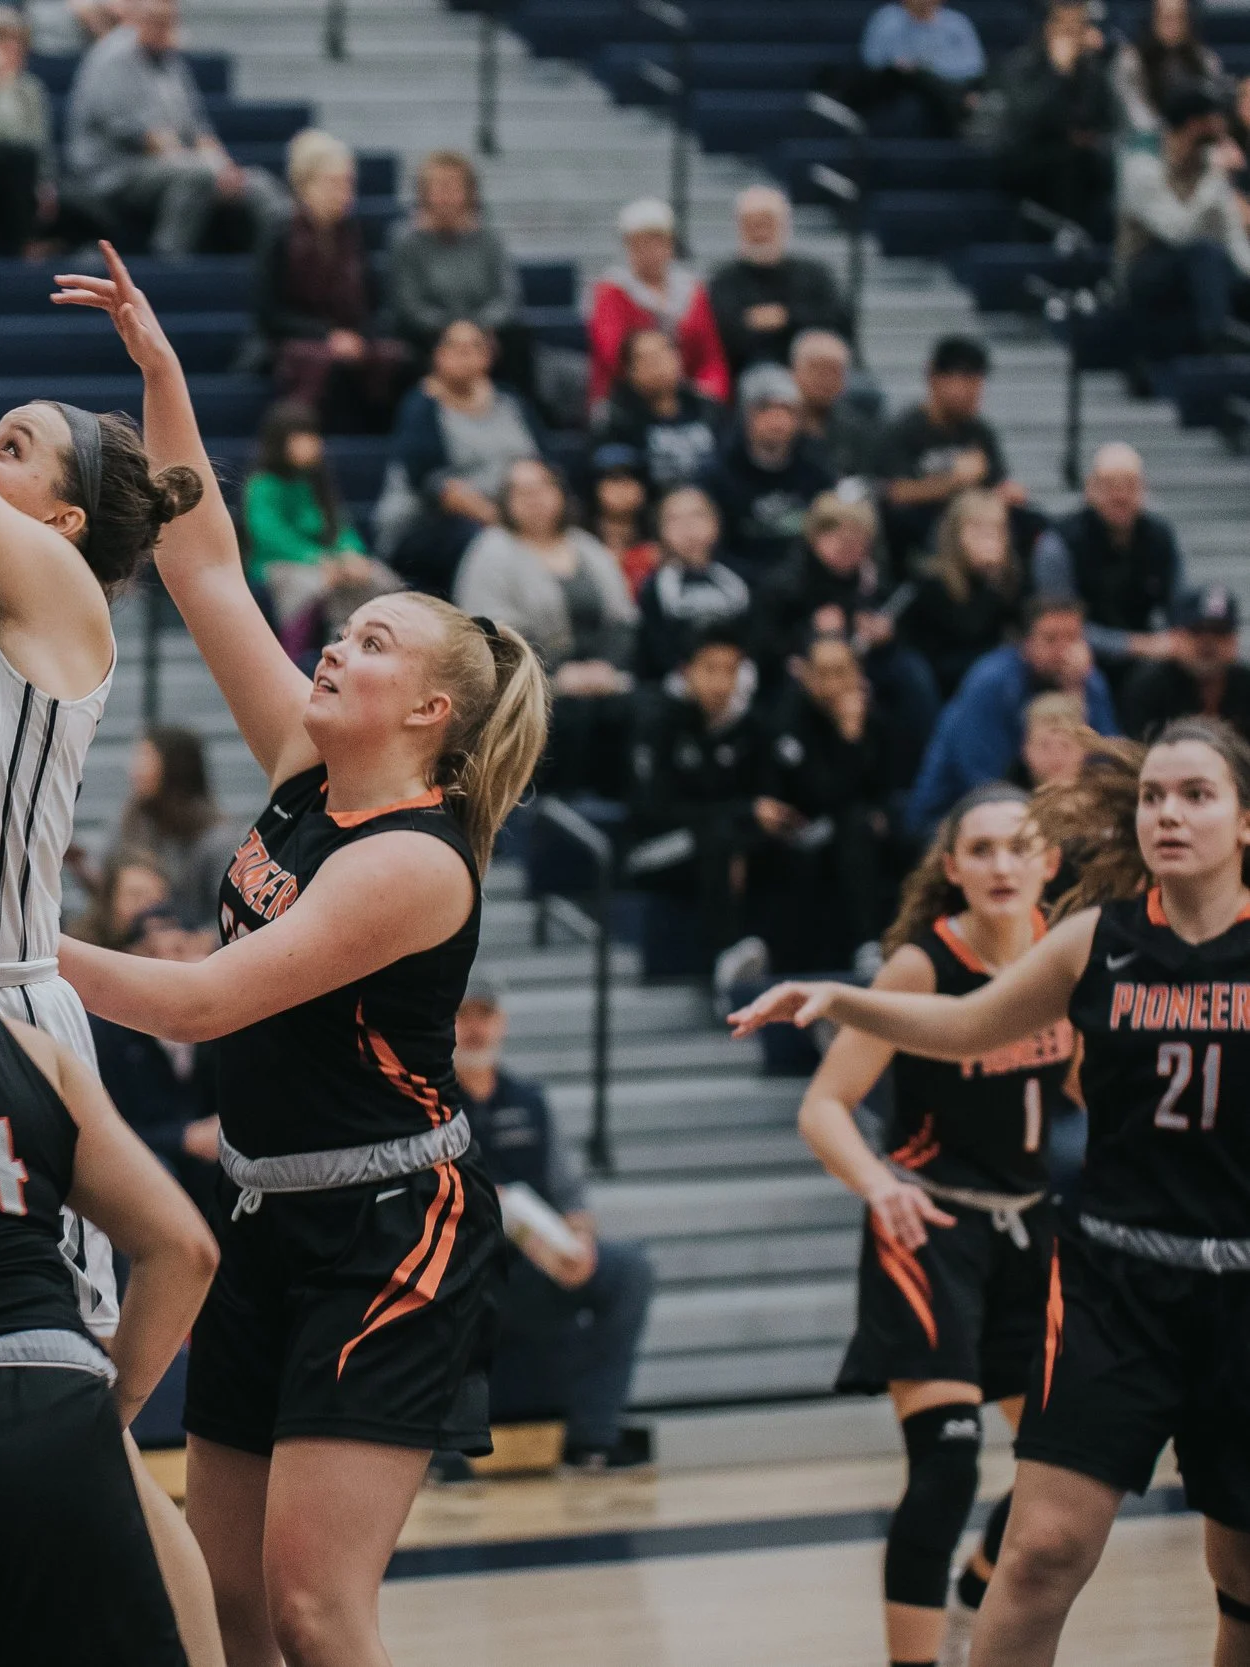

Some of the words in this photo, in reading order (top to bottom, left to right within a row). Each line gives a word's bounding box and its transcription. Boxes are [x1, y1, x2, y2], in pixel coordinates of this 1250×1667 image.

[1109, 982, 1250, 1031] PIONEER
[1023, 1077, 1042, 1154] 1
[1154, 1041, 1222, 1131] 21
